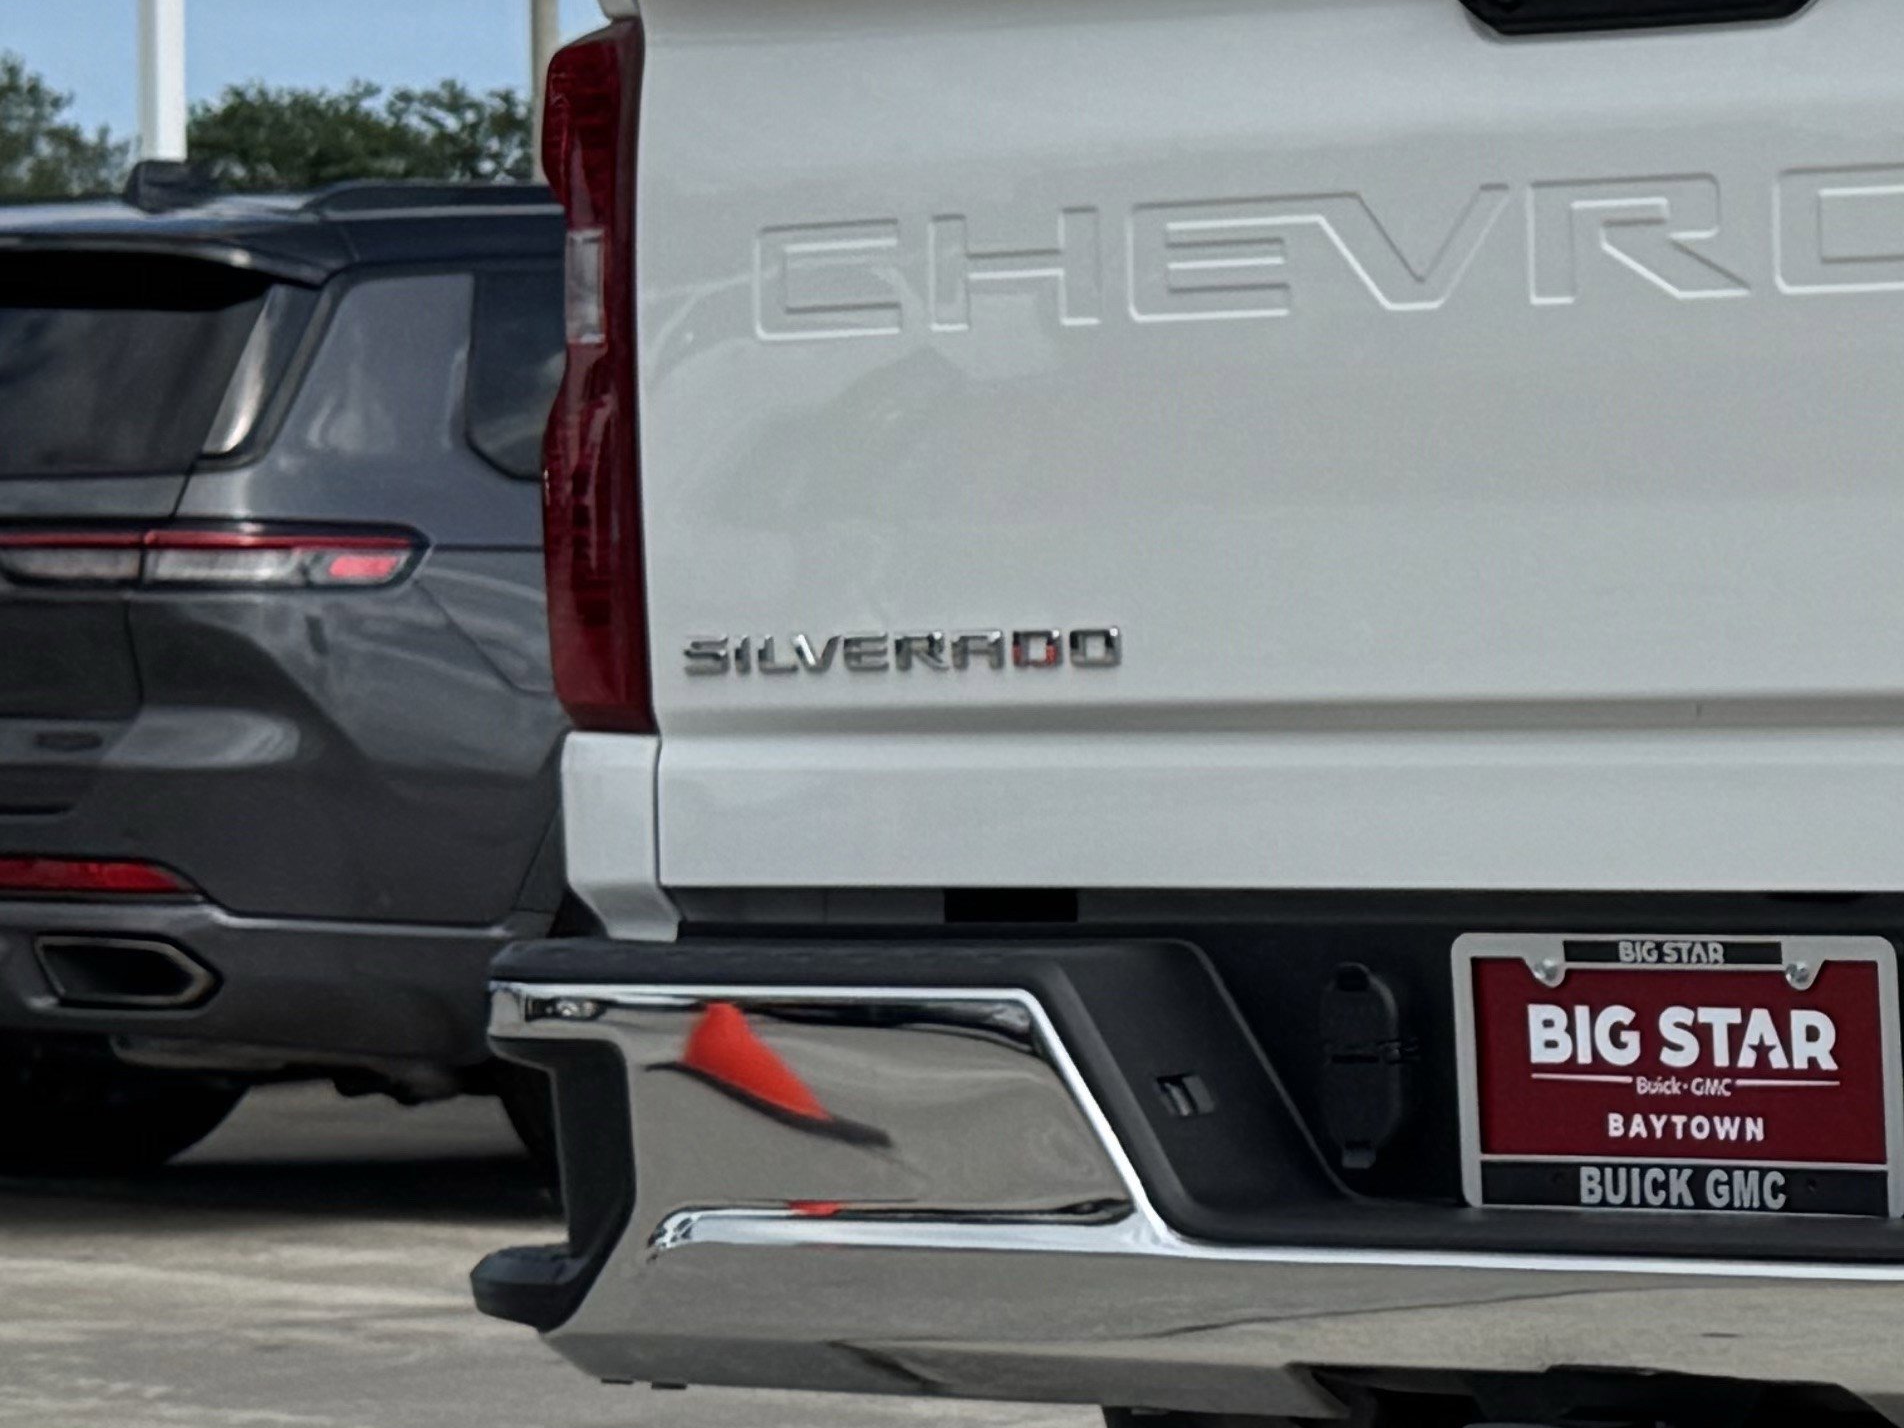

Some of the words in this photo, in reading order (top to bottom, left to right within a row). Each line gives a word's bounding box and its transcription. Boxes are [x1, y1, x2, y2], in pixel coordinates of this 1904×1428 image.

[684, 626, 1123, 674] SILVERADO
[1617, 940, 1658, 964] BIG
[1662, 941, 1725, 965] STAR
[1526, 1003, 1641, 1066] BIG
[1658, 1005, 1839, 1071] STAR
[1608, 1112, 1765, 1142] BAYTOWN
[1579, 1166, 1695, 1208] BUICK
[1705, 1170, 1787, 1211] GMC
